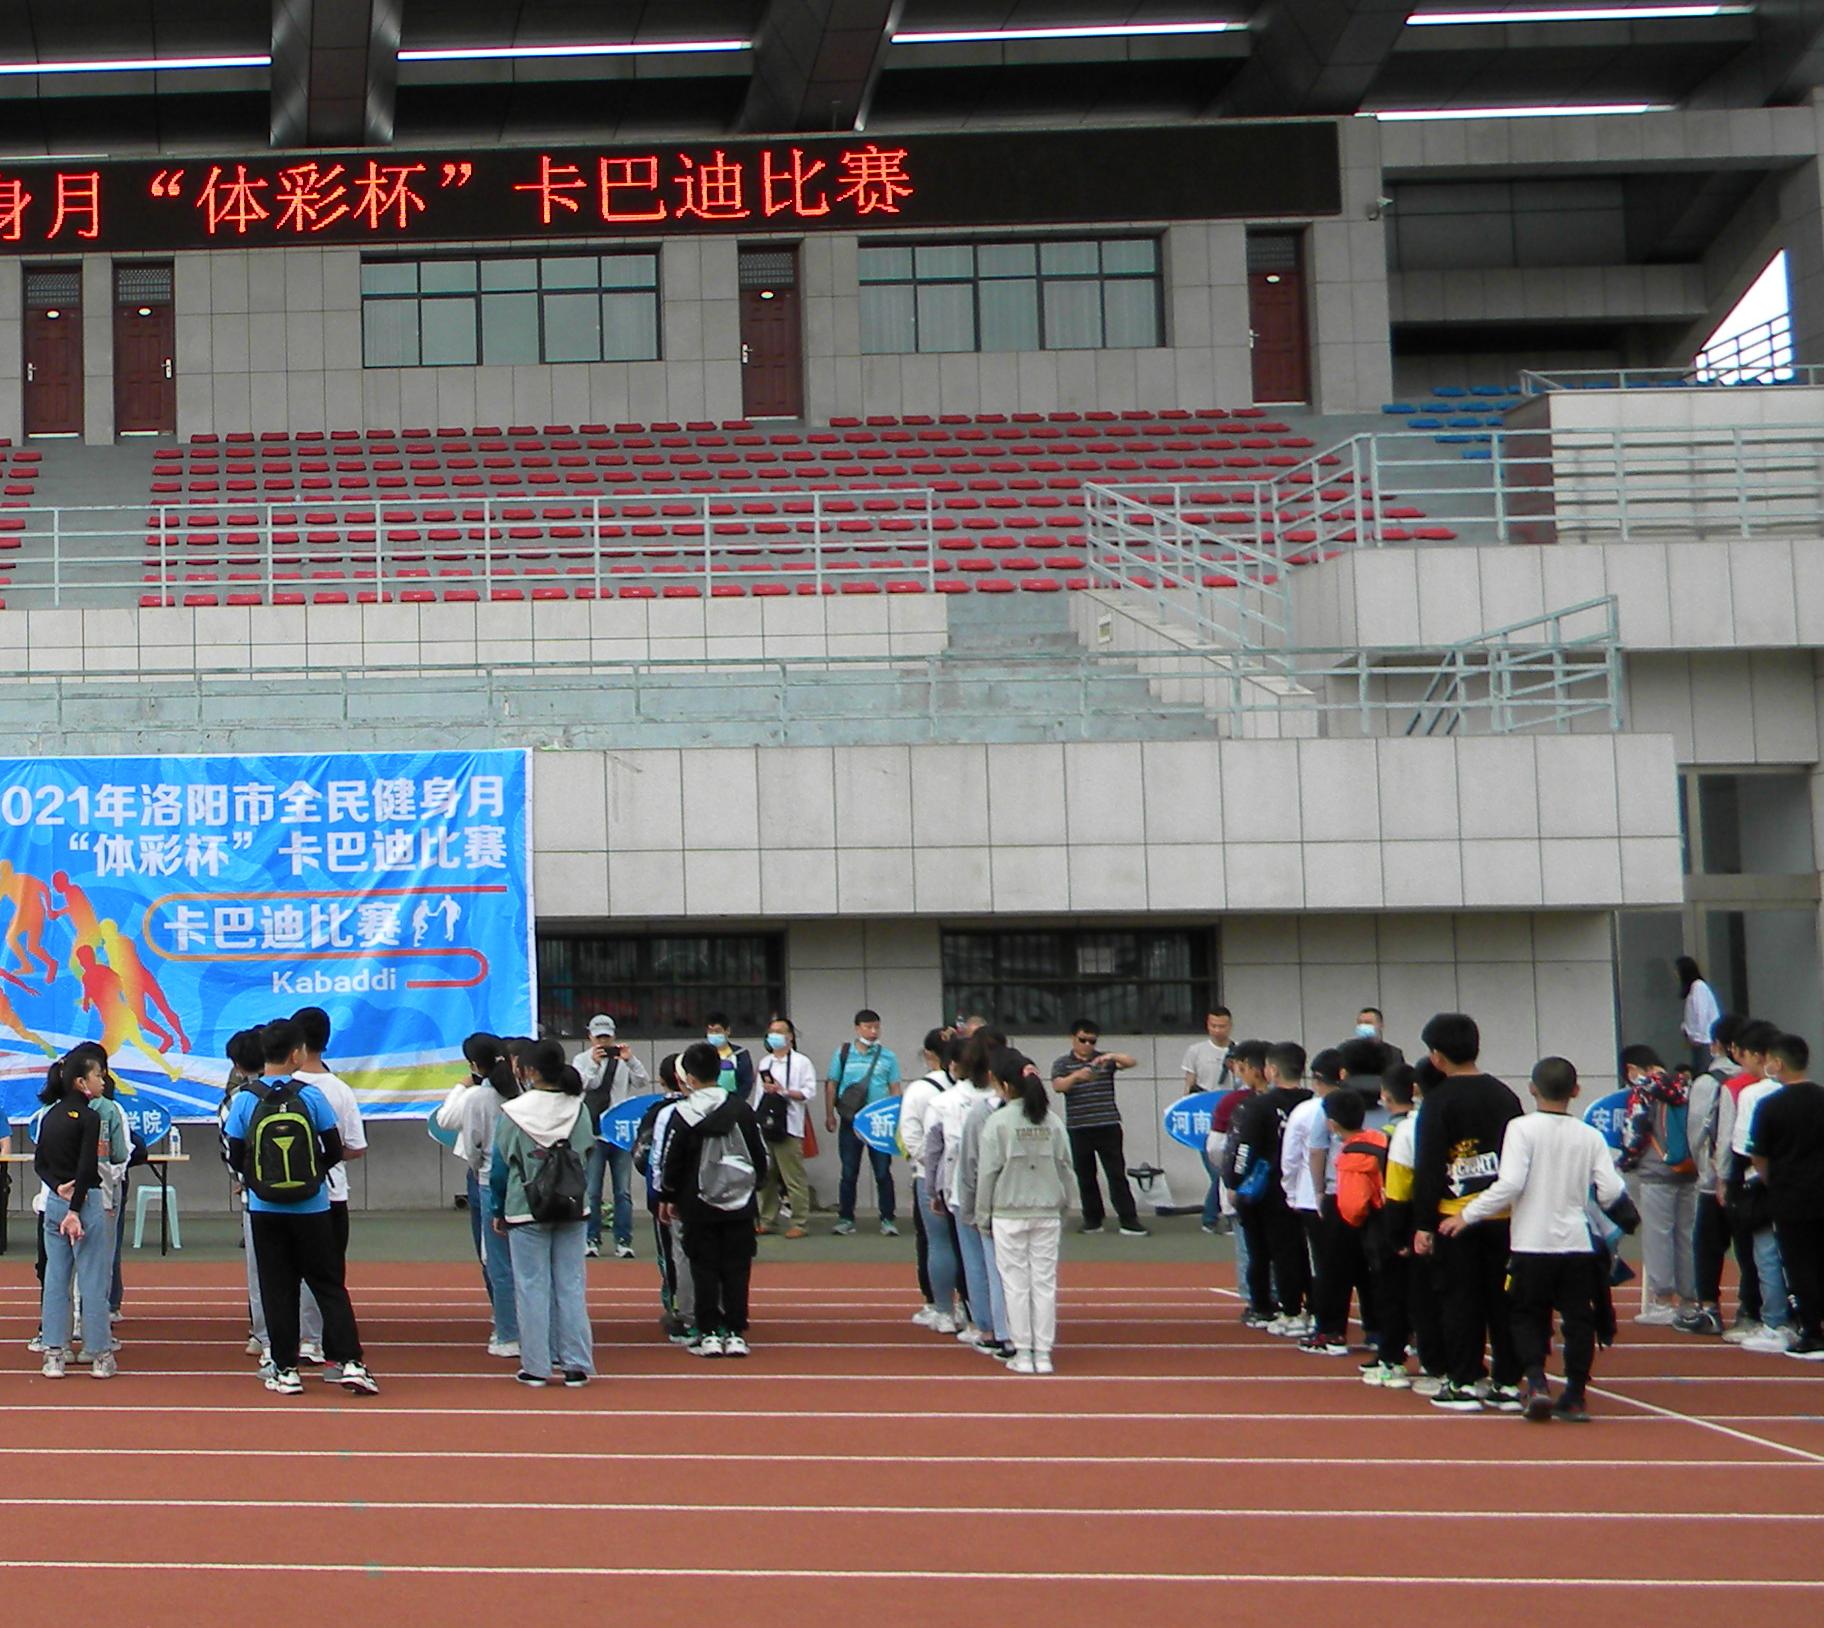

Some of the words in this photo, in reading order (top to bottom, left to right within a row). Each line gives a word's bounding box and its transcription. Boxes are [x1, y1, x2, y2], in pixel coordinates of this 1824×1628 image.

[163, 902, 402, 951] 卡巴迪比赛
[272, 969, 396, 995] Kabaddi
[1171, 1109, 1212, 1136] 河南
